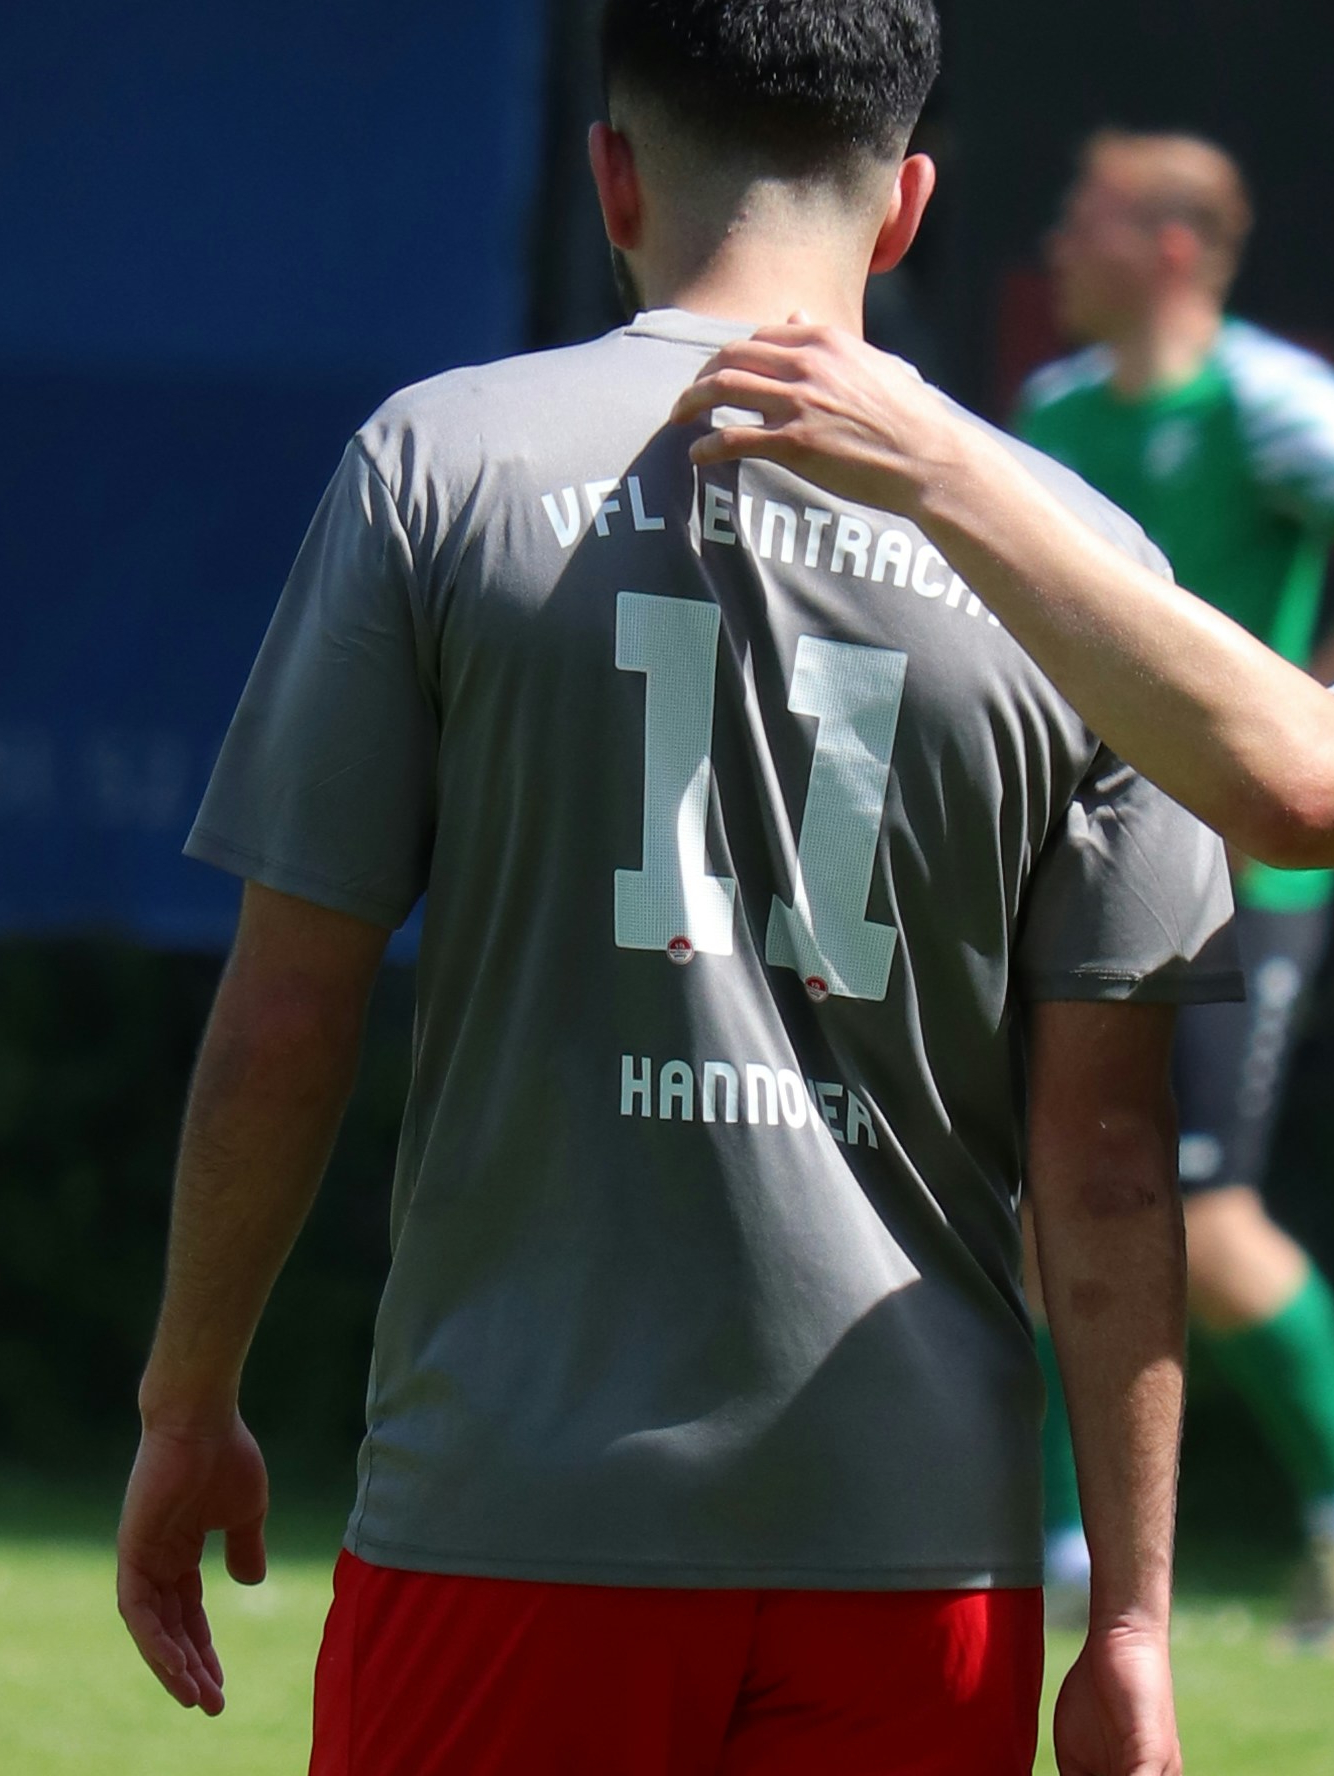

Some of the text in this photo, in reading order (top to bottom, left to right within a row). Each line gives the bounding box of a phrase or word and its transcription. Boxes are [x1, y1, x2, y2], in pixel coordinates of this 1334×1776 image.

[541, 476, 1000, 628] VFL EINTRACH
[615, 591, 908, 1003] 11
